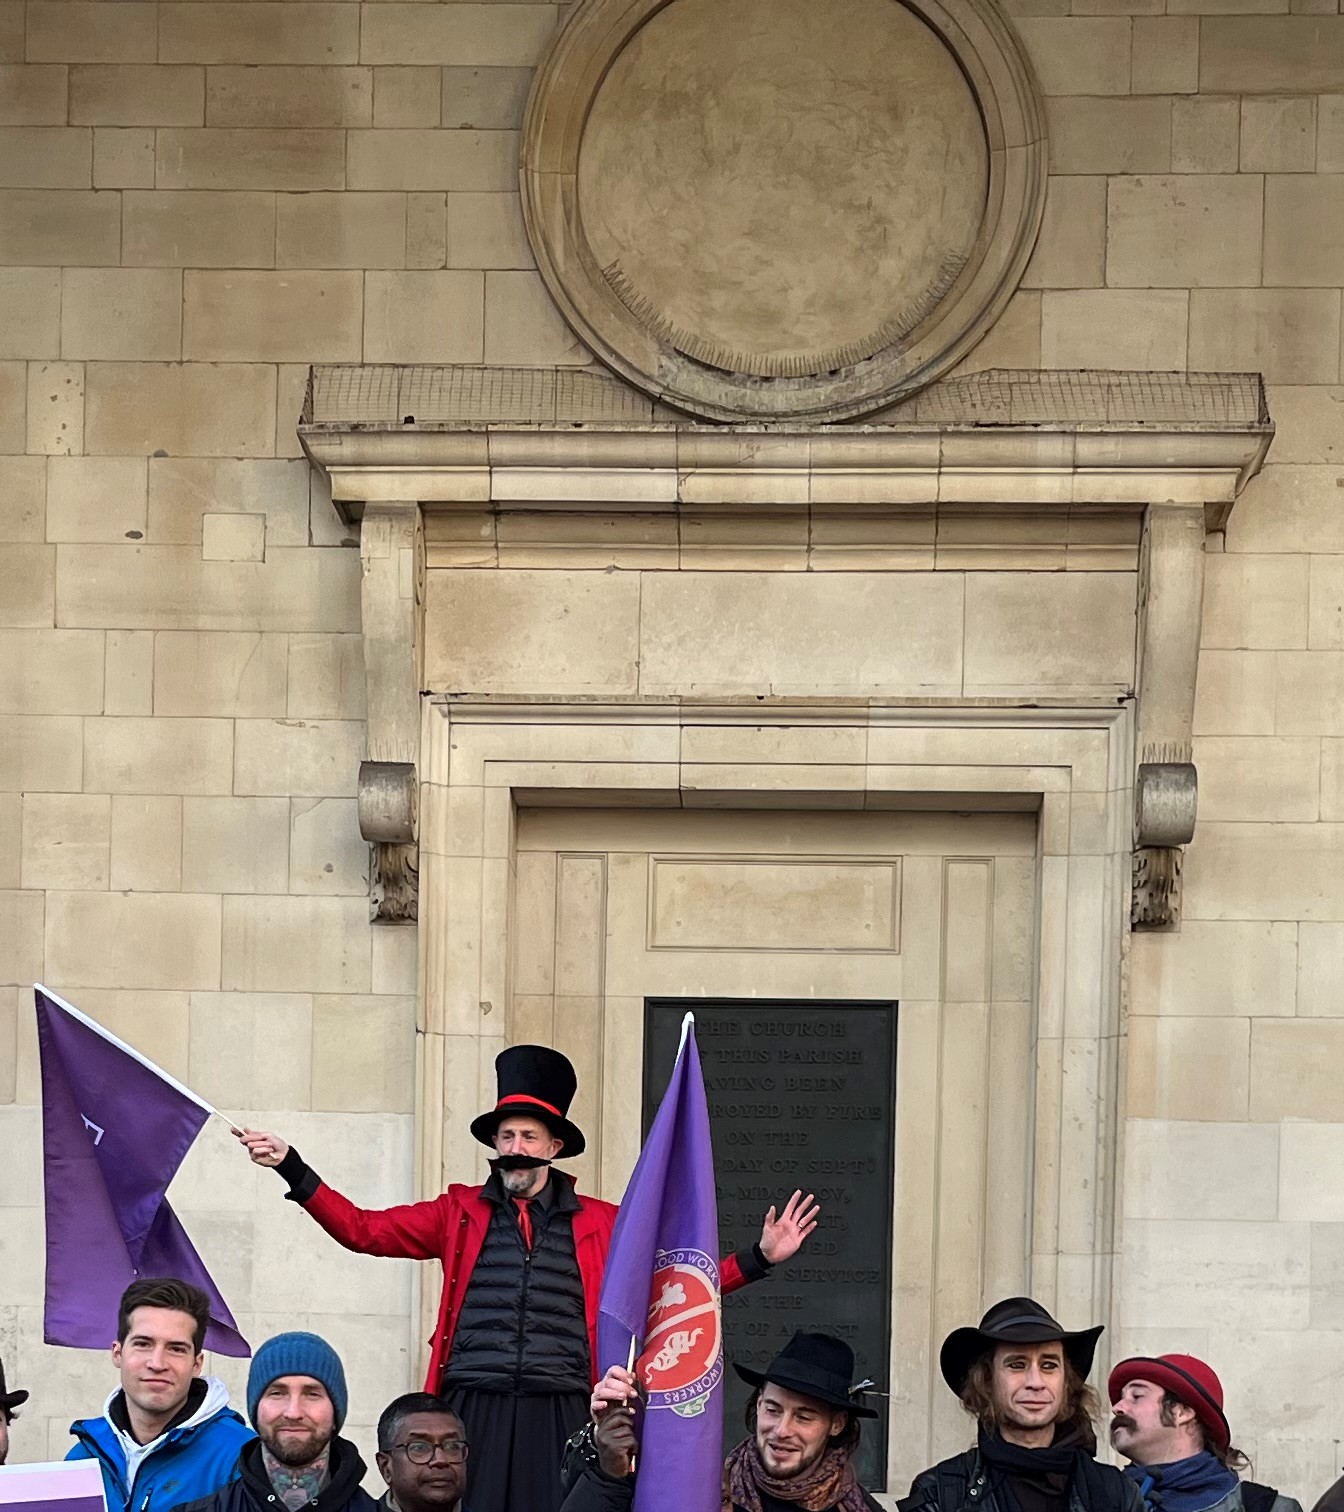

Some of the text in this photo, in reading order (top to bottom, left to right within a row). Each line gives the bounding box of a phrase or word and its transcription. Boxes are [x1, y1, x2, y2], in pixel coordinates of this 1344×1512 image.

[749, 1022, 847, 1037] CHURCH
[718, 1049, 770, 1064] THIS
[777, 1049, 863, 1065] PARISH
[785, 1077, 847, 1092] BEEN
[791, 1104, 818, 1119] BY
[825, 1104, 882, 1121] FIRE
[725, 1131, 810, 1146] ON THE
[656, 1252, 718, 1283] OOD WORK
[784, 1268, 880, 1284] SERVICE
[663, 1368, 719, 1404] WORKERS
